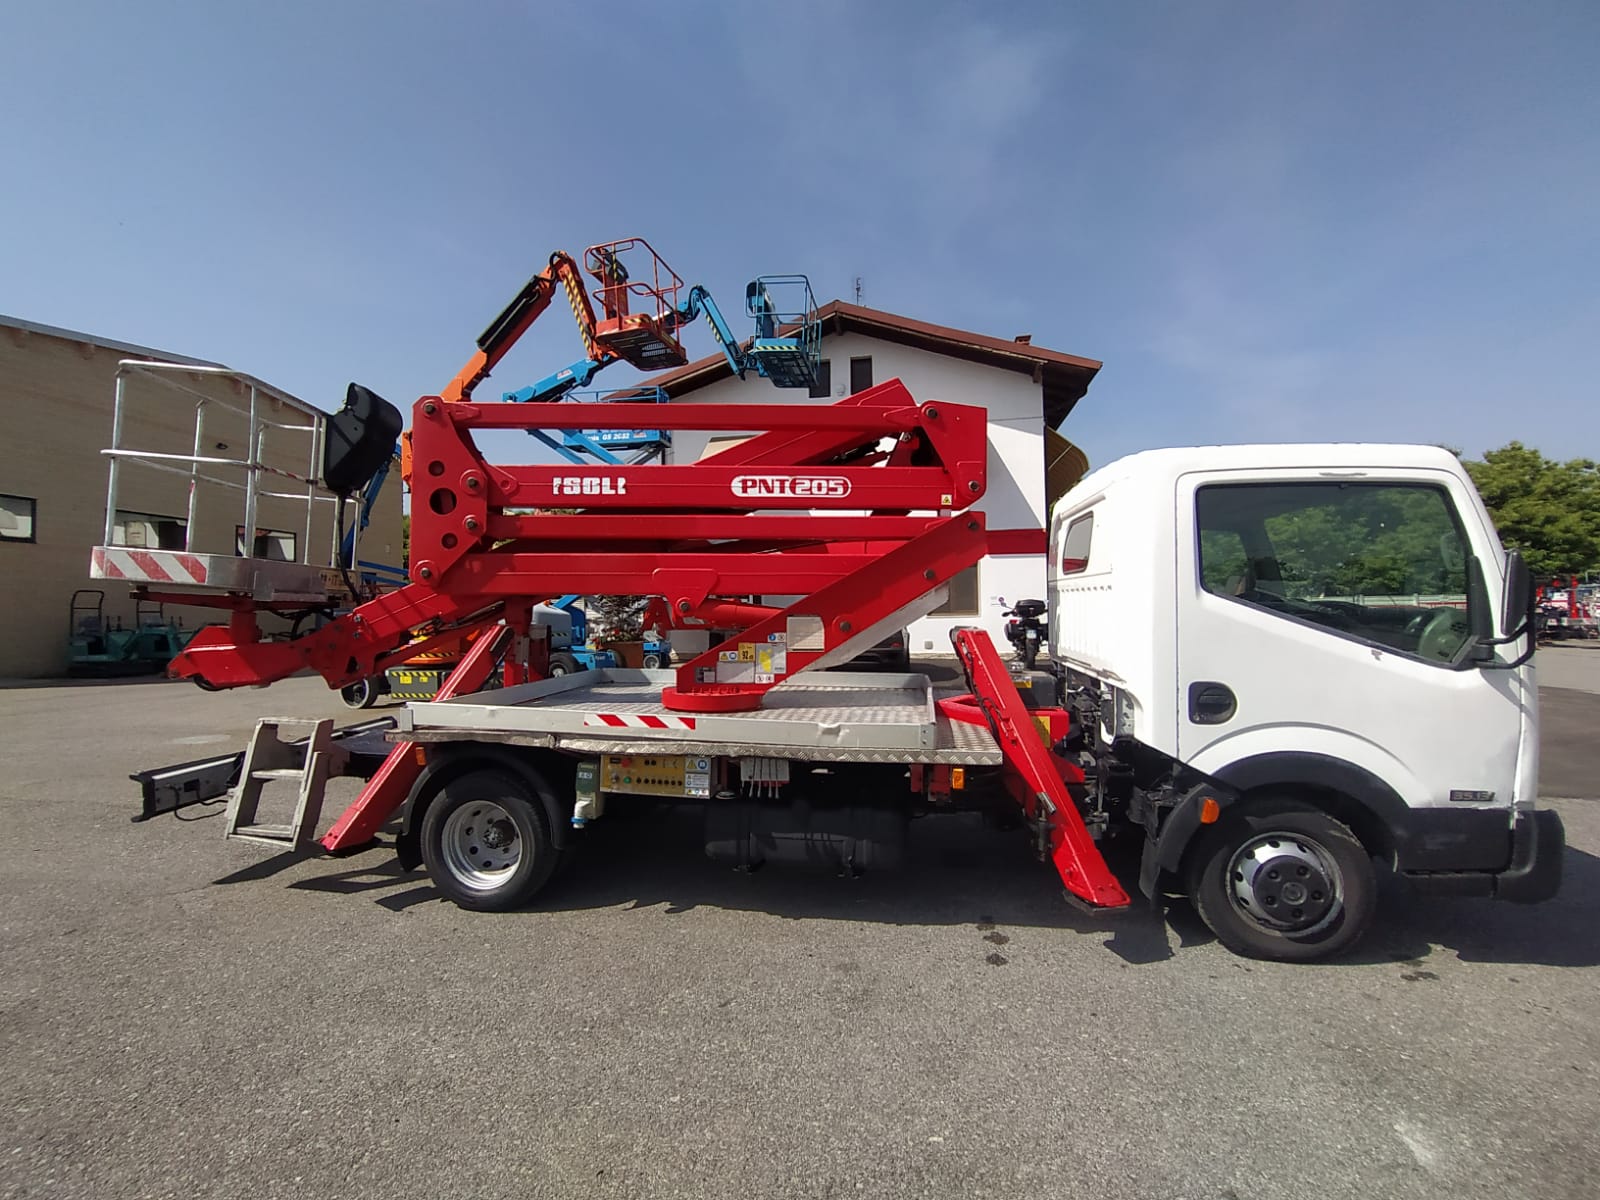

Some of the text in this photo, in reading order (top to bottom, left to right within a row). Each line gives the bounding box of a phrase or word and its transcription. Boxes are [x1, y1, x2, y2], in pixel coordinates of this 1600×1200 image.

[552, 477, 627, 495] ISOLI
[740, 478, 845, 495] PNT 205
